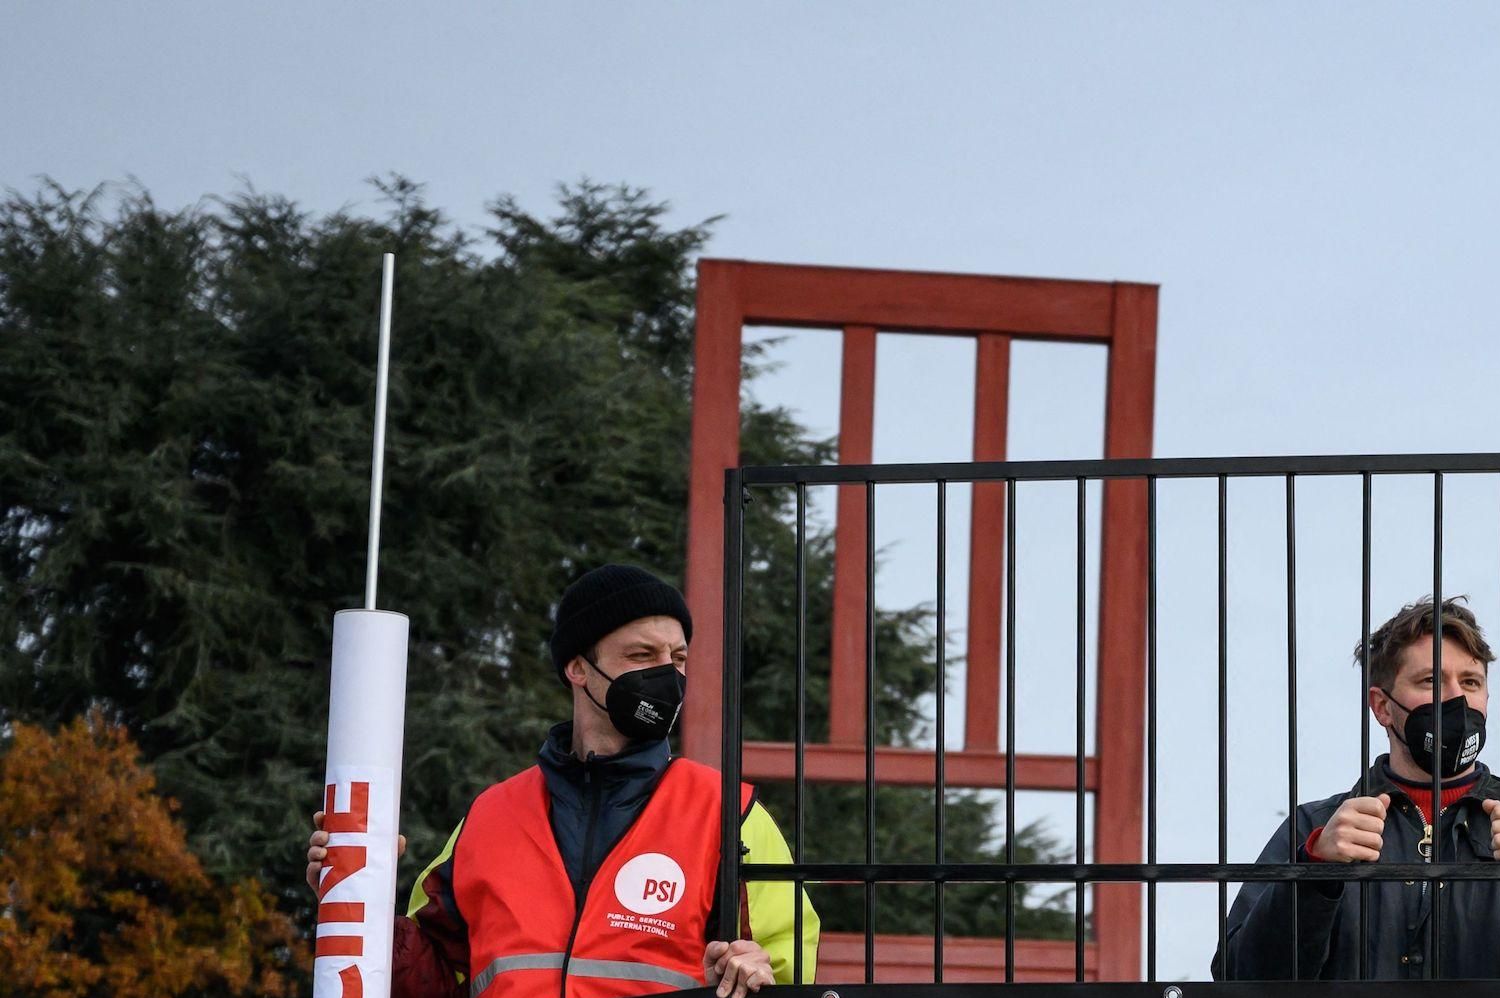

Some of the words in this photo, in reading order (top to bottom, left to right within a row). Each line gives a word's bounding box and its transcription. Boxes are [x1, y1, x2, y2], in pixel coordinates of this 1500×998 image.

[643, 879, 676, 902] PSI
[607, 913, 635, 921] PUBLIC
[639, 917, 675, 930] SERVICES
[610, 921, 668, 937] INTERNATIONAL
